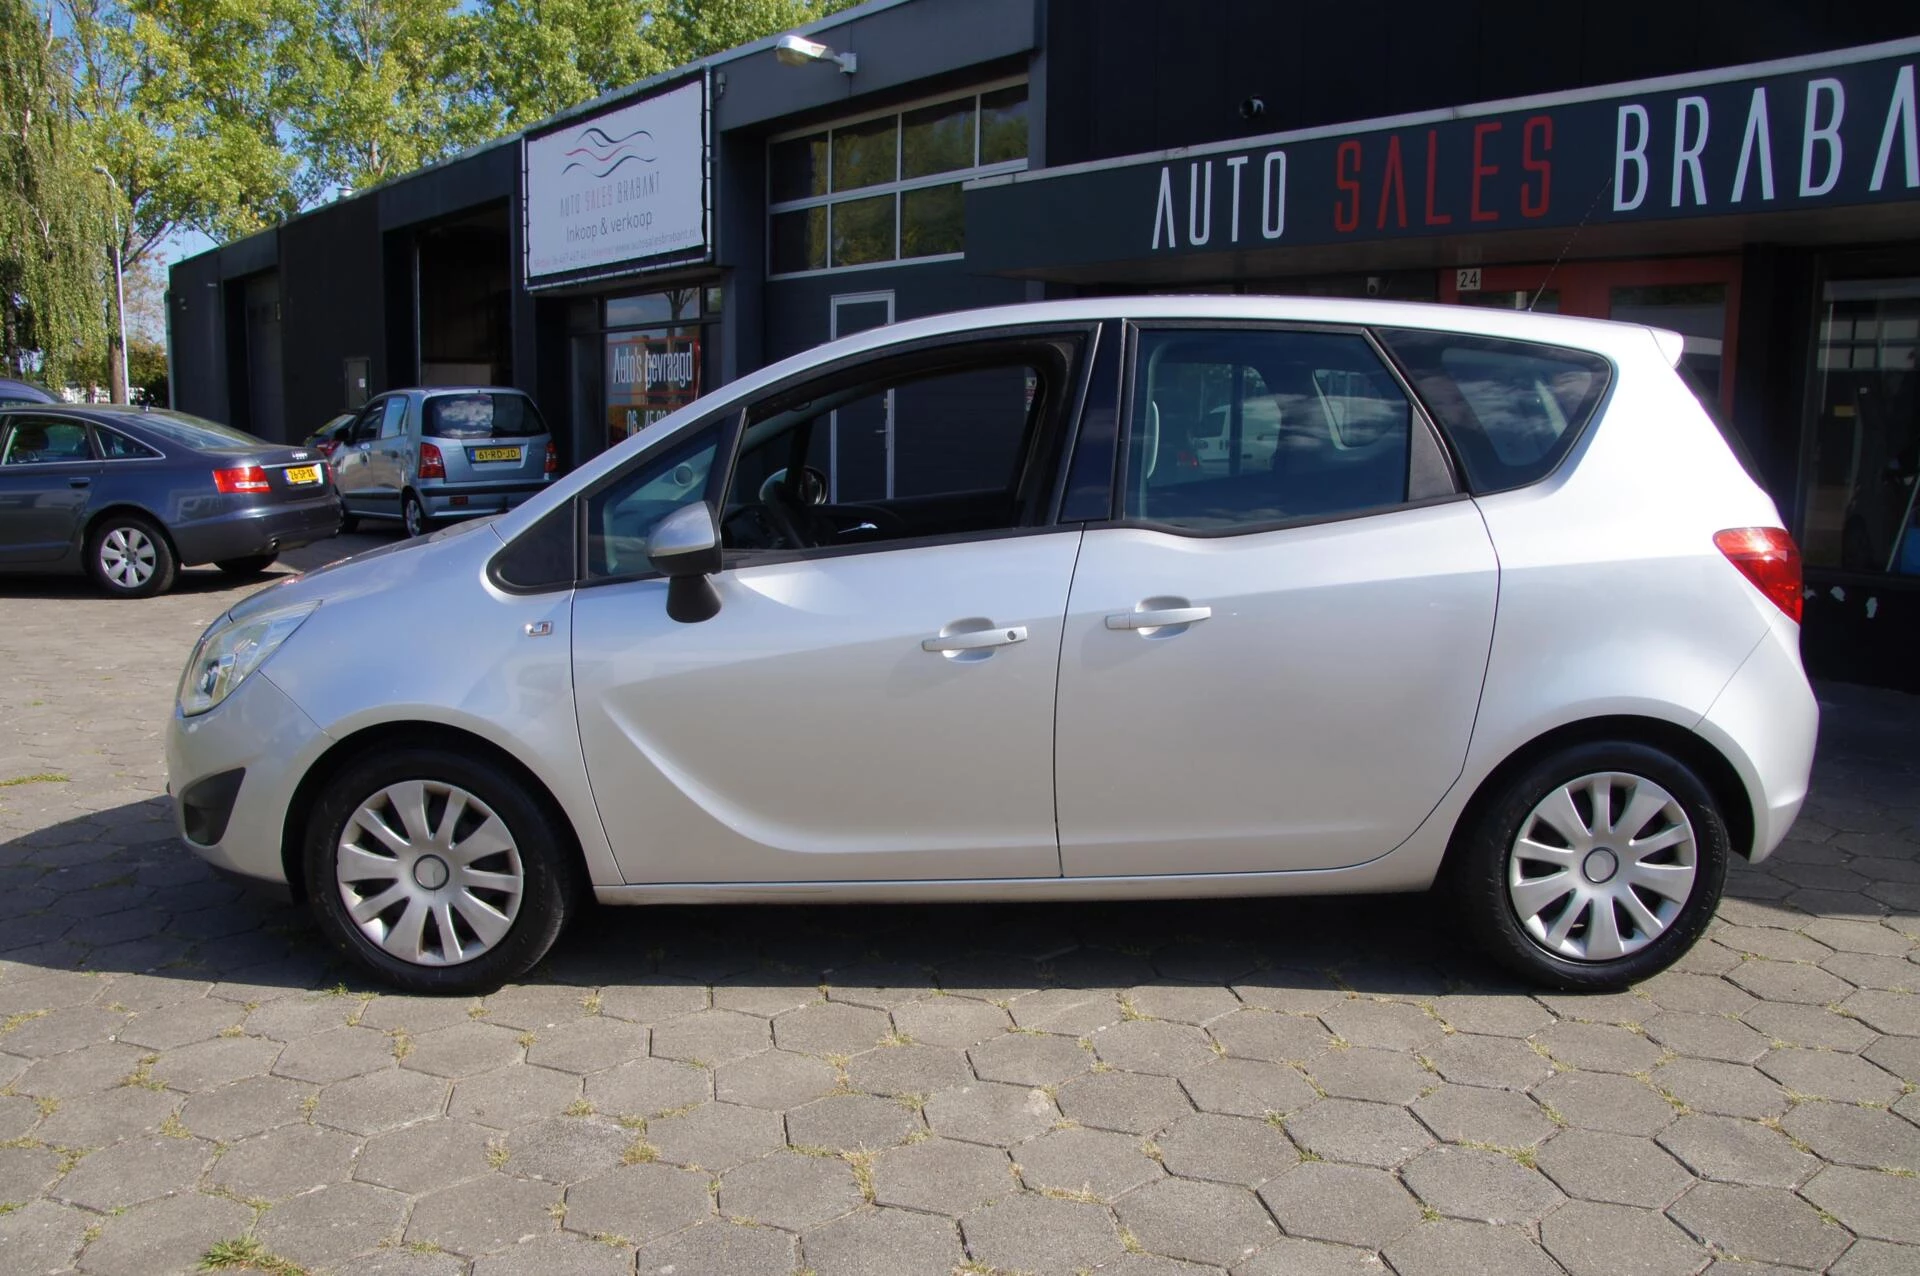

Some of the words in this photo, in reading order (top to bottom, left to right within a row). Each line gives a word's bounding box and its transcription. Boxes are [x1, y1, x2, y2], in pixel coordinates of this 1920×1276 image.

[1152, 151, 1287, 249] AUTO
[1334, 115, 1553, 233] SALES
[1613, 64, 1920, 212] BRABA
[560, 195, 581, 218] AUTO
[585, 185, 614, 214] SALES
[617, 171, 661, 204] BRABANT
[566, 222, 598, 243] Inkoop
[600, 216, 609, 236] &
[610, 211, 653, 234] verkoop
[1460, 271, 1478, 288] 24
[613, 347, 642, 385] Auto's
[645, 342, 693, 389] gevraagd
[478, 449, 517, 460] 61-RD-JD
